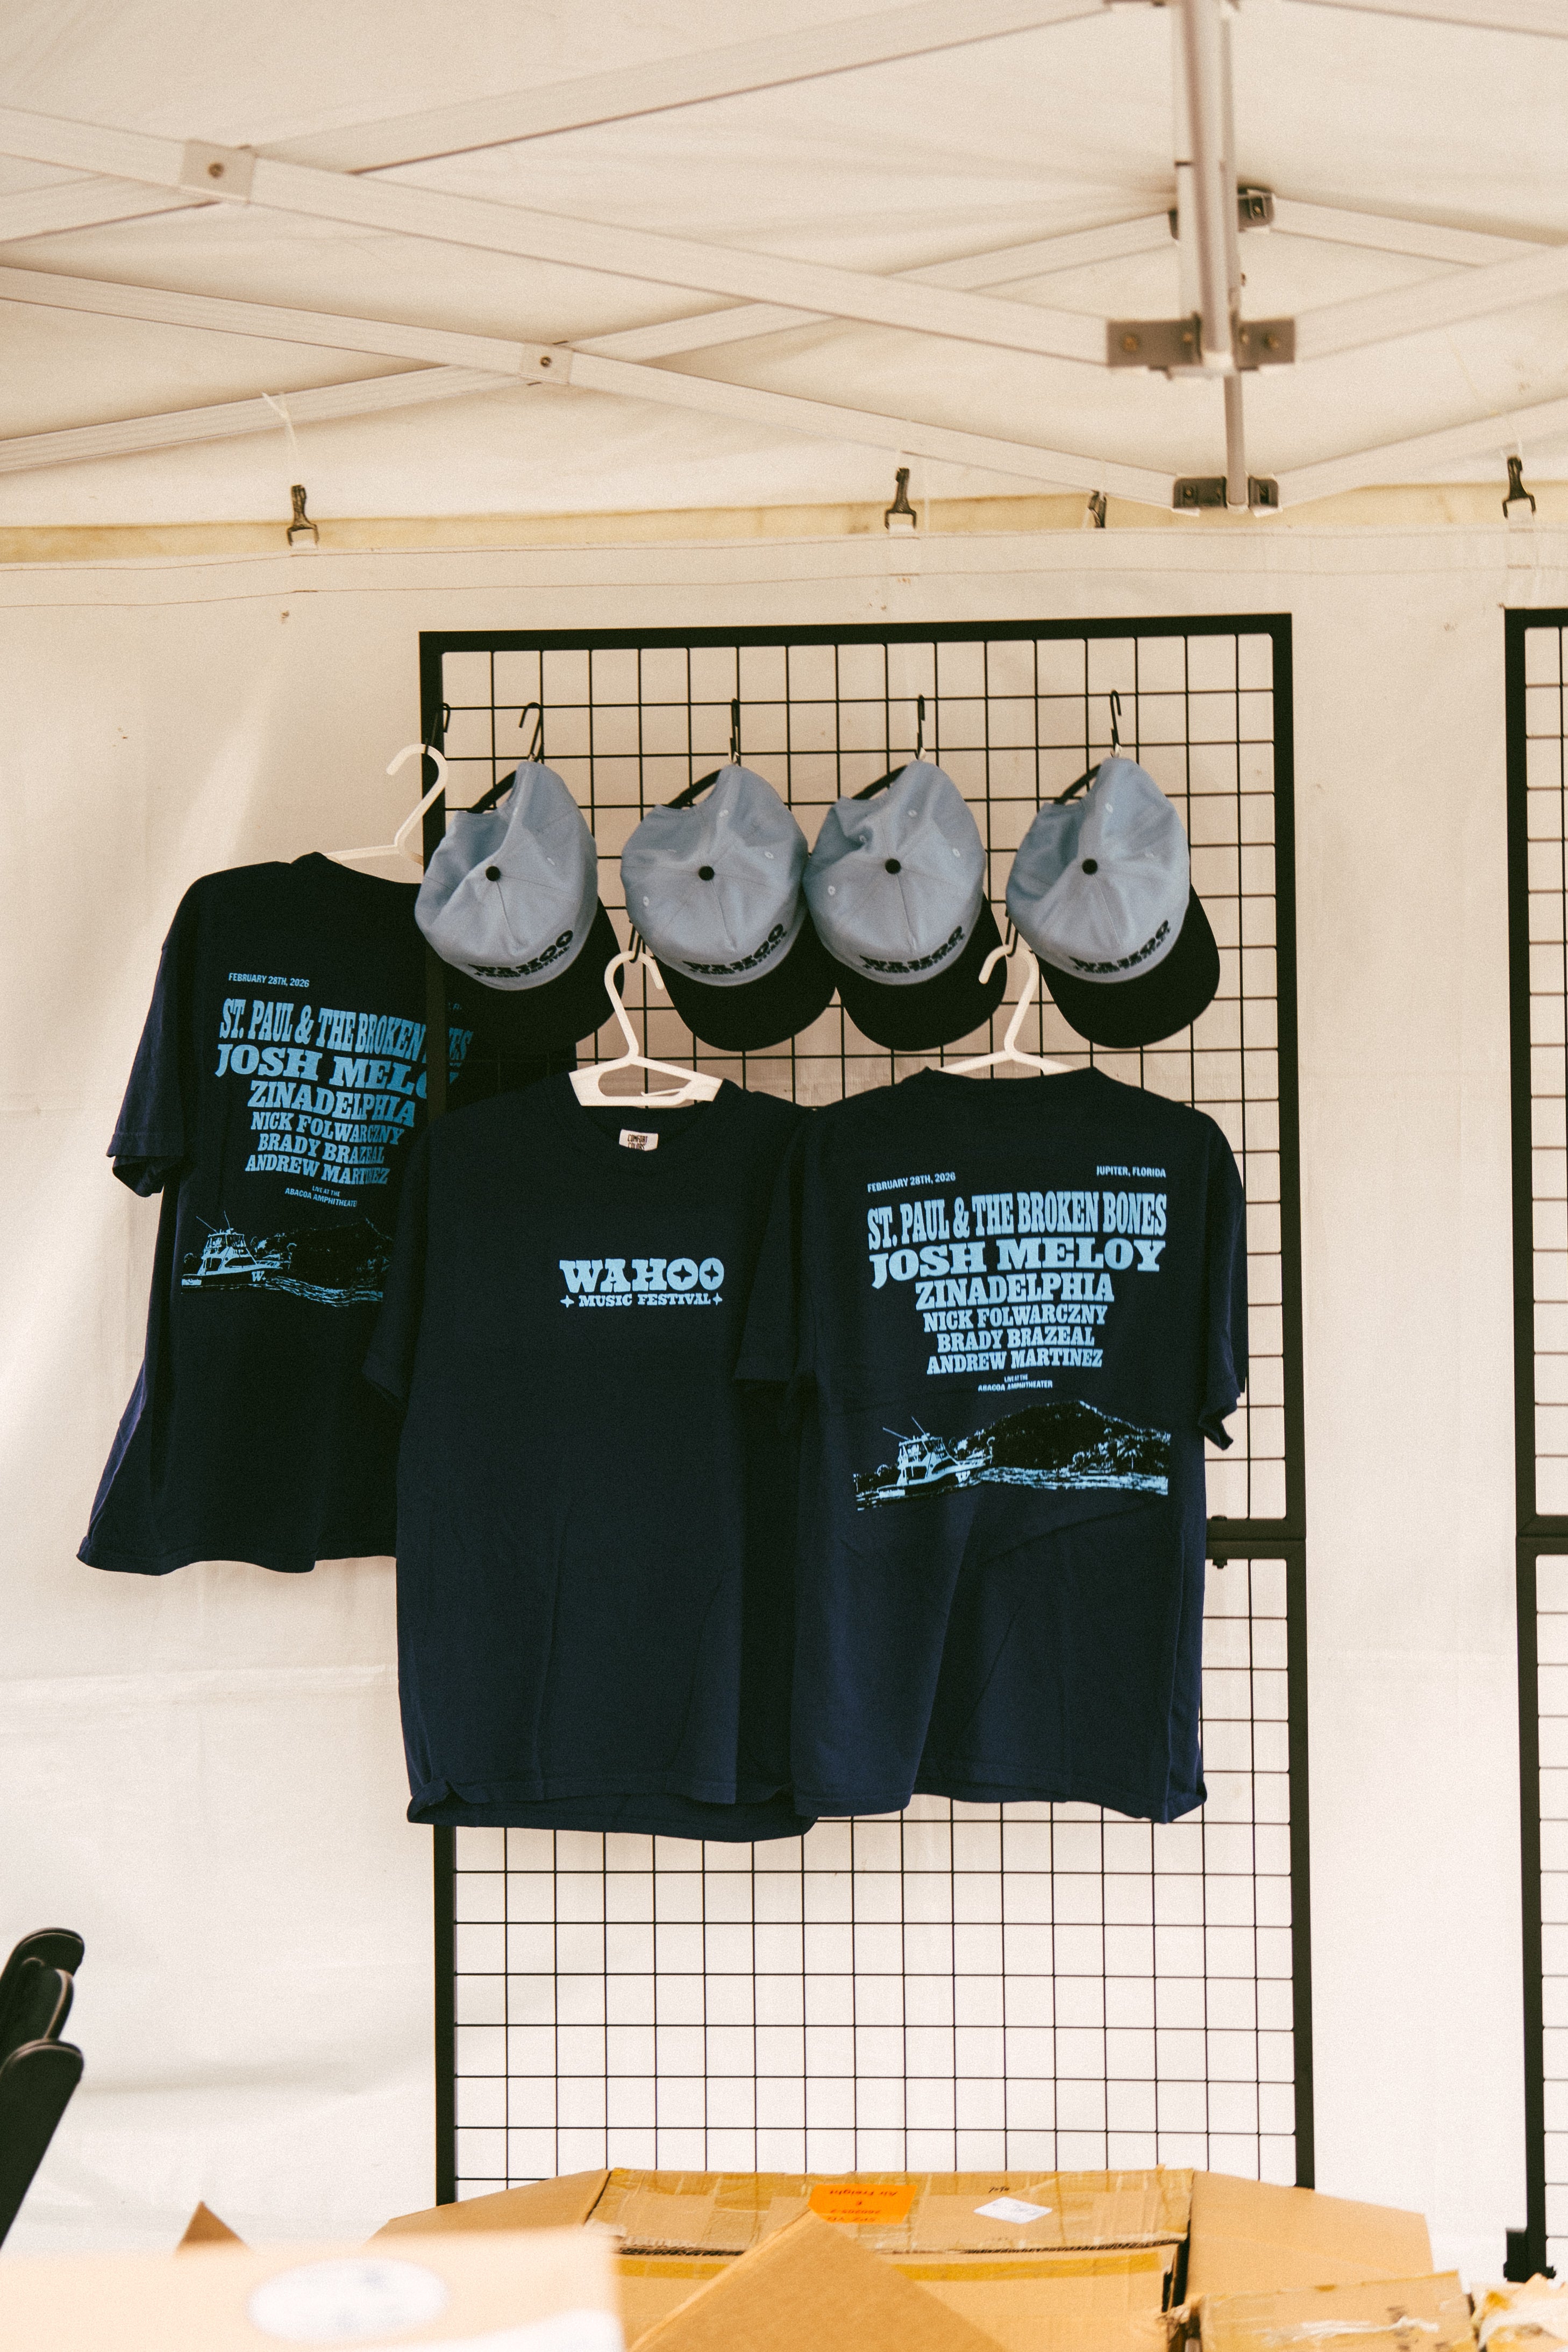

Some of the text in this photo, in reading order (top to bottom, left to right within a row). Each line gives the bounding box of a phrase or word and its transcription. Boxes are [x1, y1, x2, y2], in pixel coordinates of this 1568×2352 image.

[467, 930, 573, 974] WAHOO
[682, 923, 783, 972] WAHOO
[229, 973, 309, 987] FEBRUARY 28TH, 2026
[219, 999, 245, 1038] ST.
[248, 1000, 293, 1041] PAUL
[294, 1006, 313, 1044] &
[316, 1008, 355, 1051] THE
[355, 1013, 425, 1061] BROKEN
[215, 1044, 322, 1080] JOSH
[248, 1080, 415, 1127] ZINADELPHIA
[251, 1112, 403, 1144] NICK FOLWARCZNY
[258, 1134, 383, 1164] BRADY BRAZEAL
[245, 1154, 389, 1184] ANDREW MARTINEZ
[868, 1172, 955, 1192] FEBRUARY 28TH, 2026
[1097, 1166, 1166, 1177] JUPITER, FLORIDA
[285, 1188, 356, 1206] ABACOA AMPHITHEATE
[867, 1191, 1166, 1250] ST. PAUL & THE BROKEN BONES
[559, 1258, 724, 1293] WAHOO
[869, 1237, 1166, 1289] JOSH MELOY
[579, 1293, 711, 1307] MUSIC FESTIVAL
[916, 1272, 1114, 1310] ZINADELPHIA
[923, 1303, 1108, 1332] NICK FOLWARCZNY
[937, 1327, 1094, 1353] BRADY BRAZEAL
[927, 1349, 1103, 1374] ANDREW MARTINEZ
[1007, 1380, 1052, 1391] AMPHITHEATER
